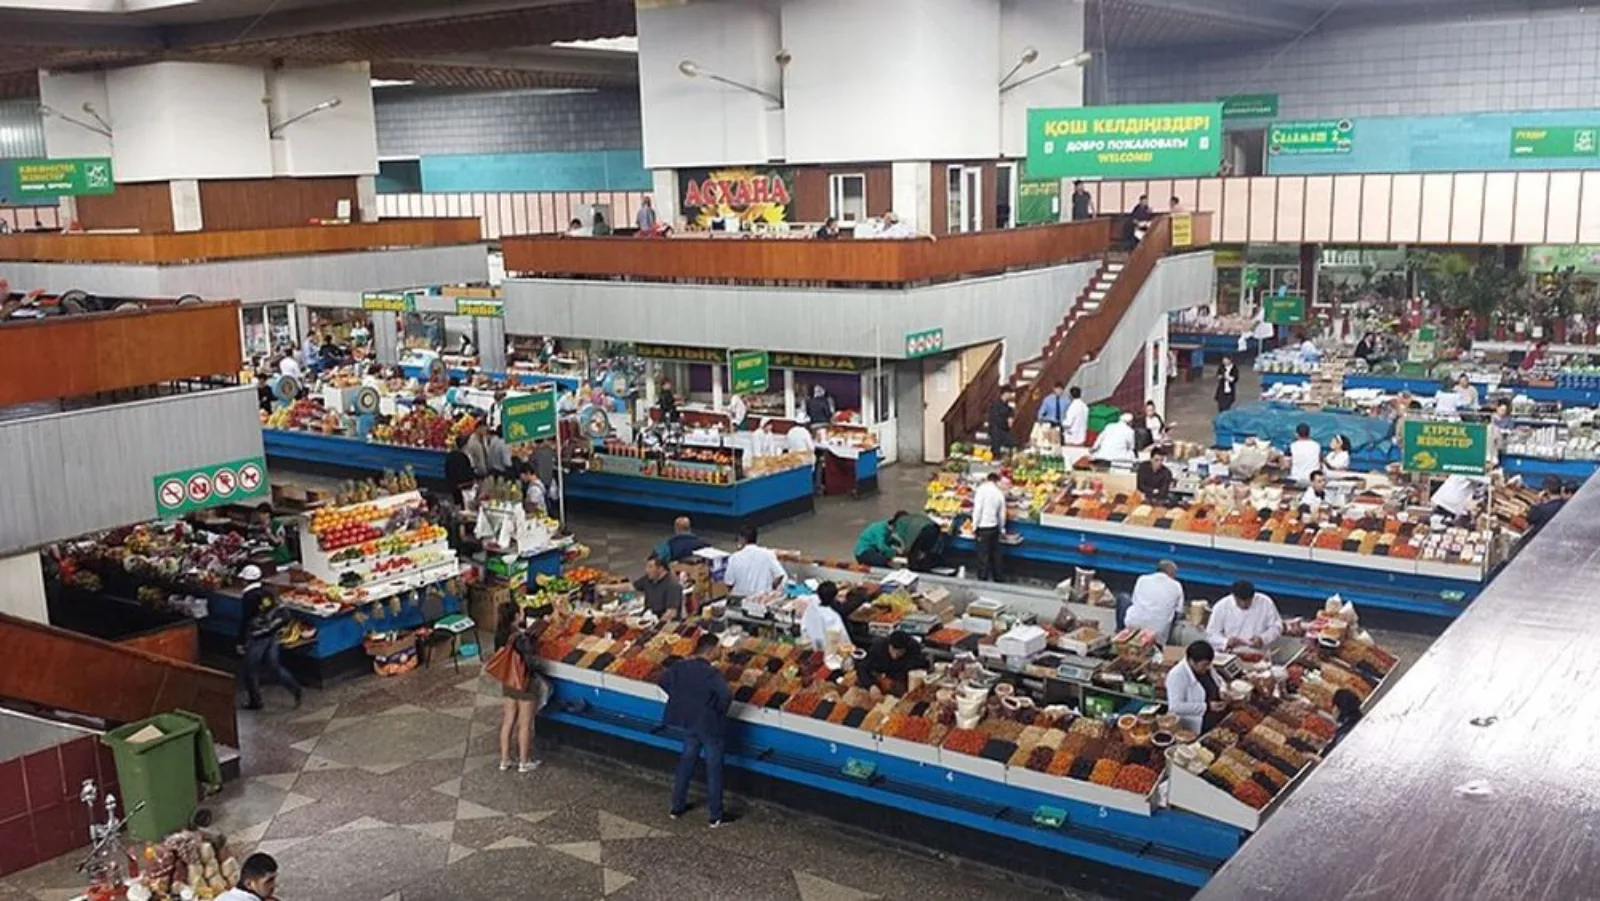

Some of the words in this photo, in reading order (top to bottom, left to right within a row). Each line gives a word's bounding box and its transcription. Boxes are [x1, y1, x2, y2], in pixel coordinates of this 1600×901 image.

[1045, 120, 1088, 136] ҚОШ
[1065, 140, 1106, 154] ДОБРО
[684, 175, 790, 206] АСХАНА
[774, 352, 855, 370] РЫБА
